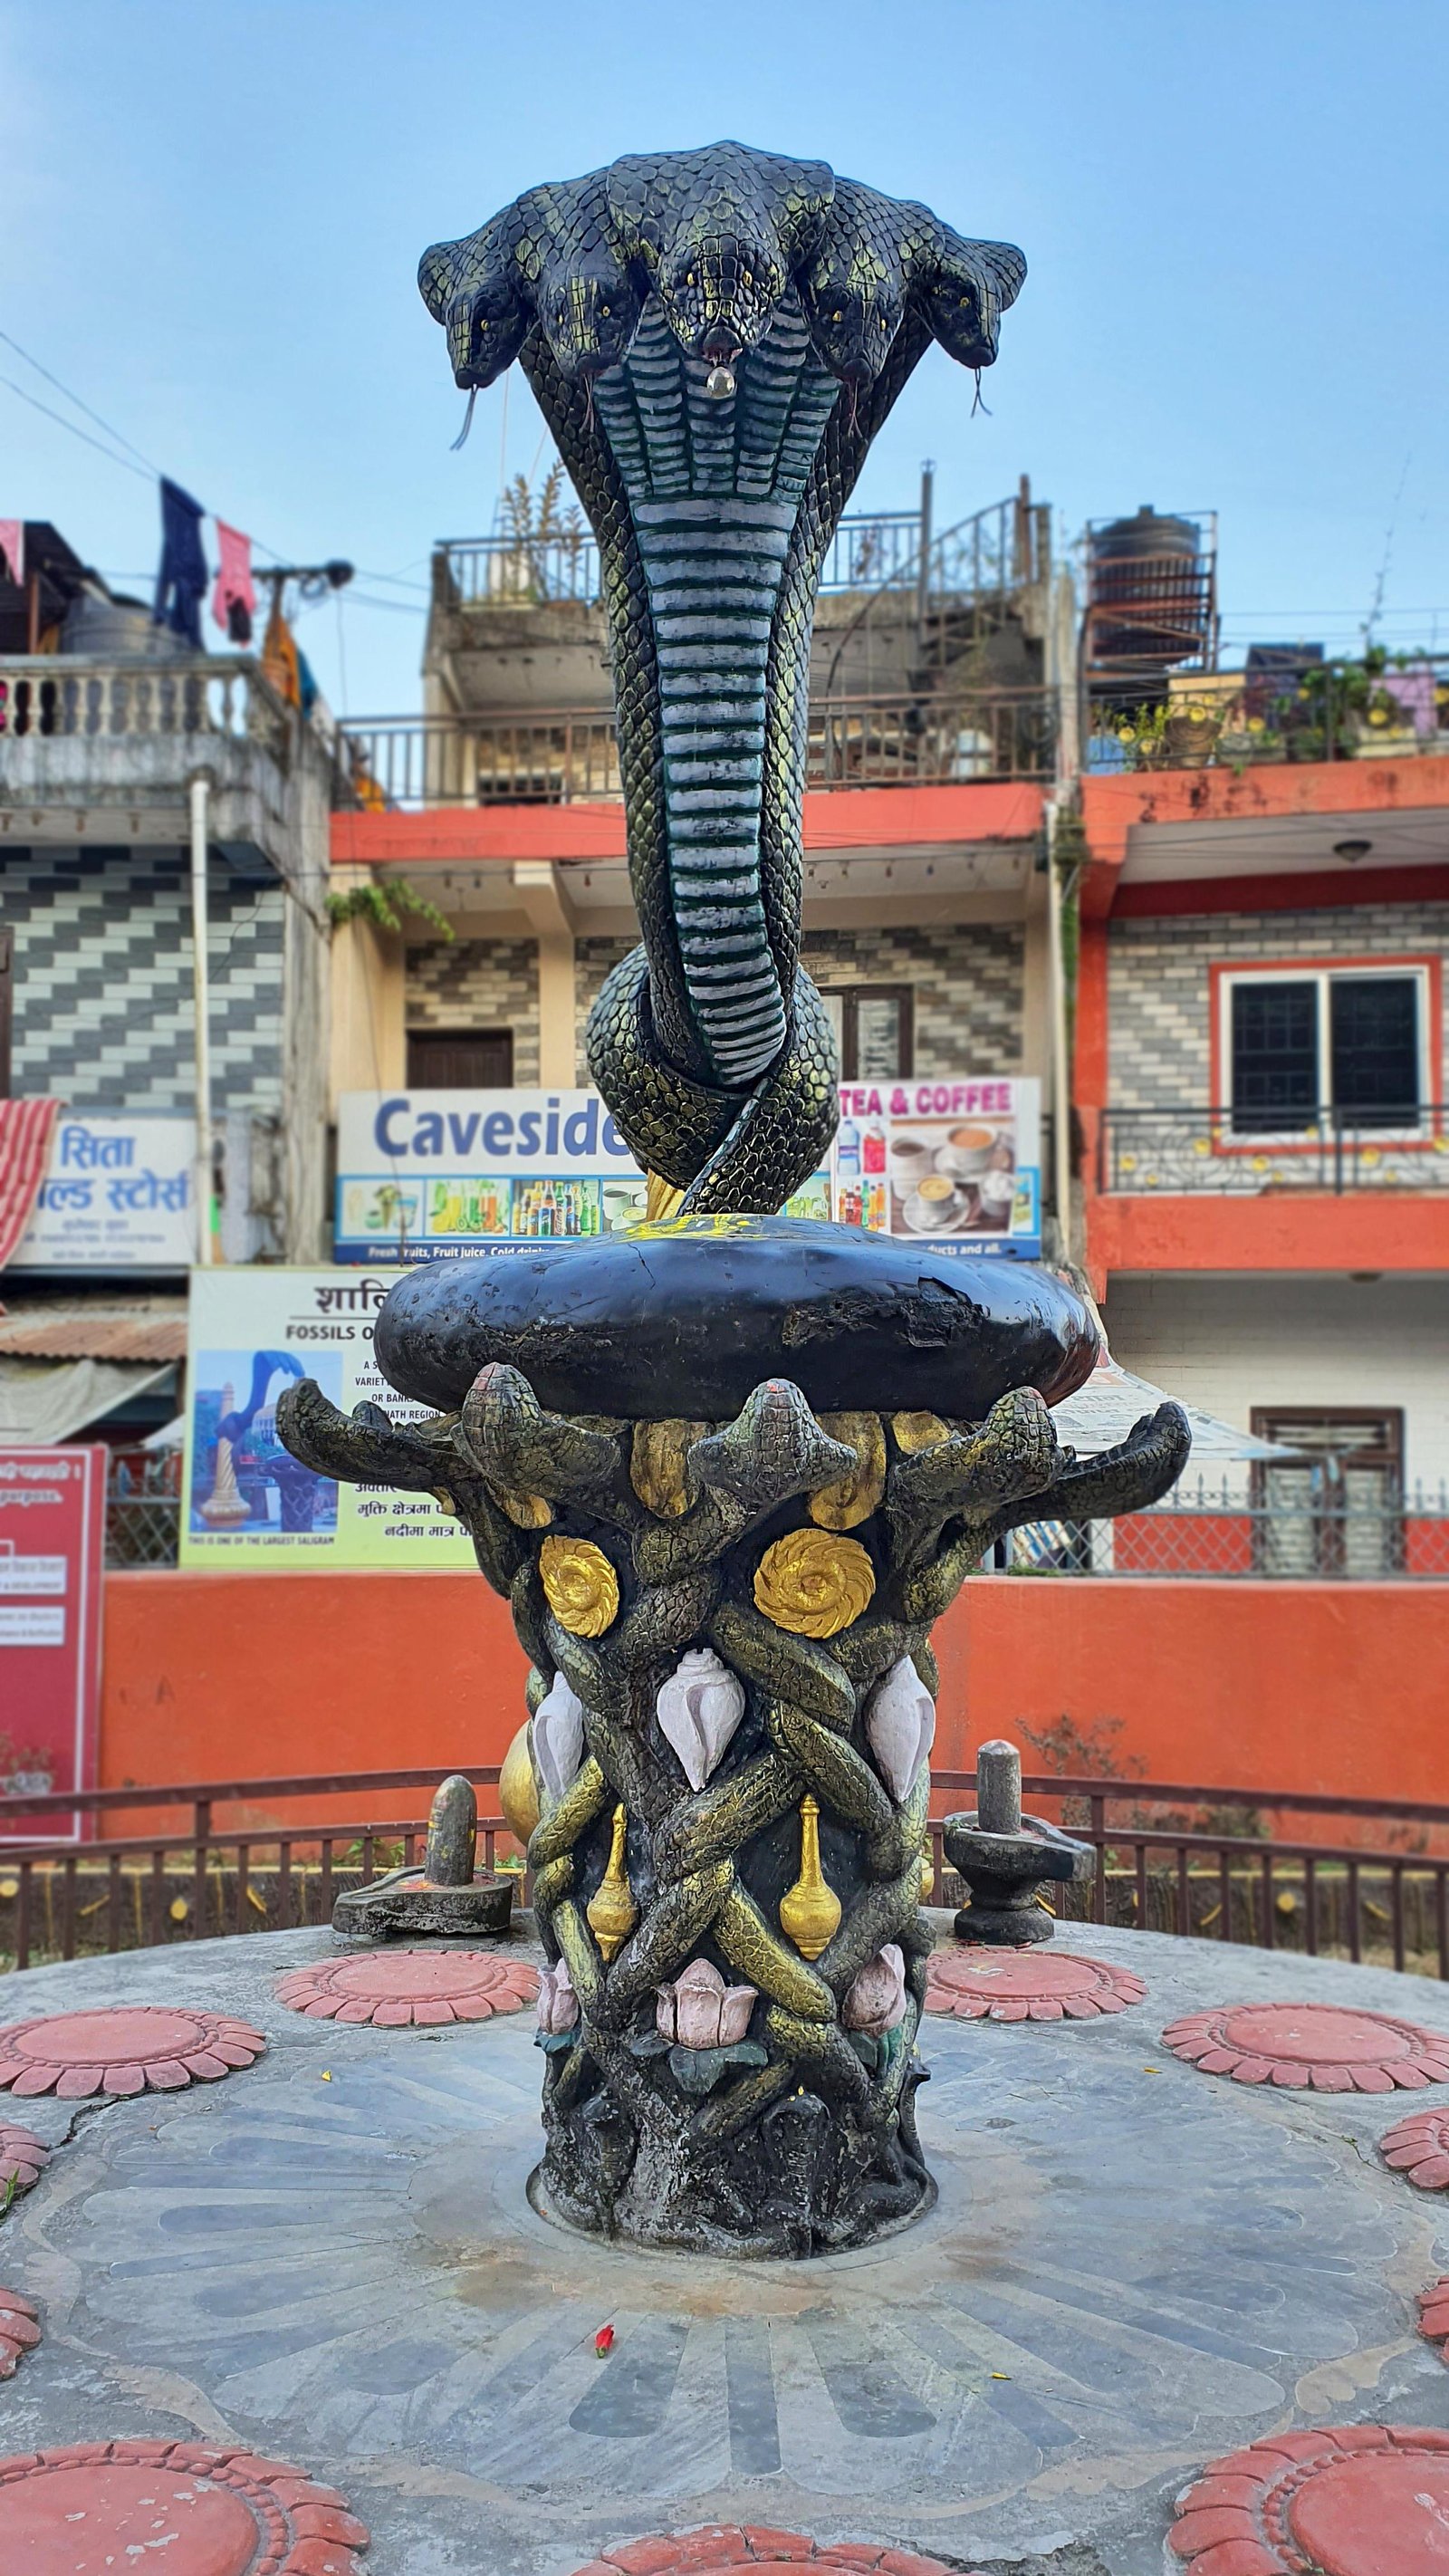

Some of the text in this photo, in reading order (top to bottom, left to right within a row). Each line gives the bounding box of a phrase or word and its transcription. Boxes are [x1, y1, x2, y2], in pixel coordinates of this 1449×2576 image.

[840, 1083, 1012, 1116] TEA & COFFEE
[375, 1098, 630, 1157] Caveside
[403, 1247, 431, 1259] ruits,
[434, 1247, 459, 1257] Fruit
[960, 1243, 983, 1254] and
[286, 1325, 375, 1340] FOSSILS O
[364, 1360, 369, 1370] A
[371, 1393, 383, 1403] OR
[408, 1409, 441, 1419] REGION
[188, 1536, 205, 1544] THIS
[216, 1536, 231, 1544] ONE
[234, 1536, 244, 1544] OF
[246, 1536, 260, 1544] THE
[263, 1536, 295, 1545] LARGEST
[297, 1536, 334, 1545] SALIGRAM
